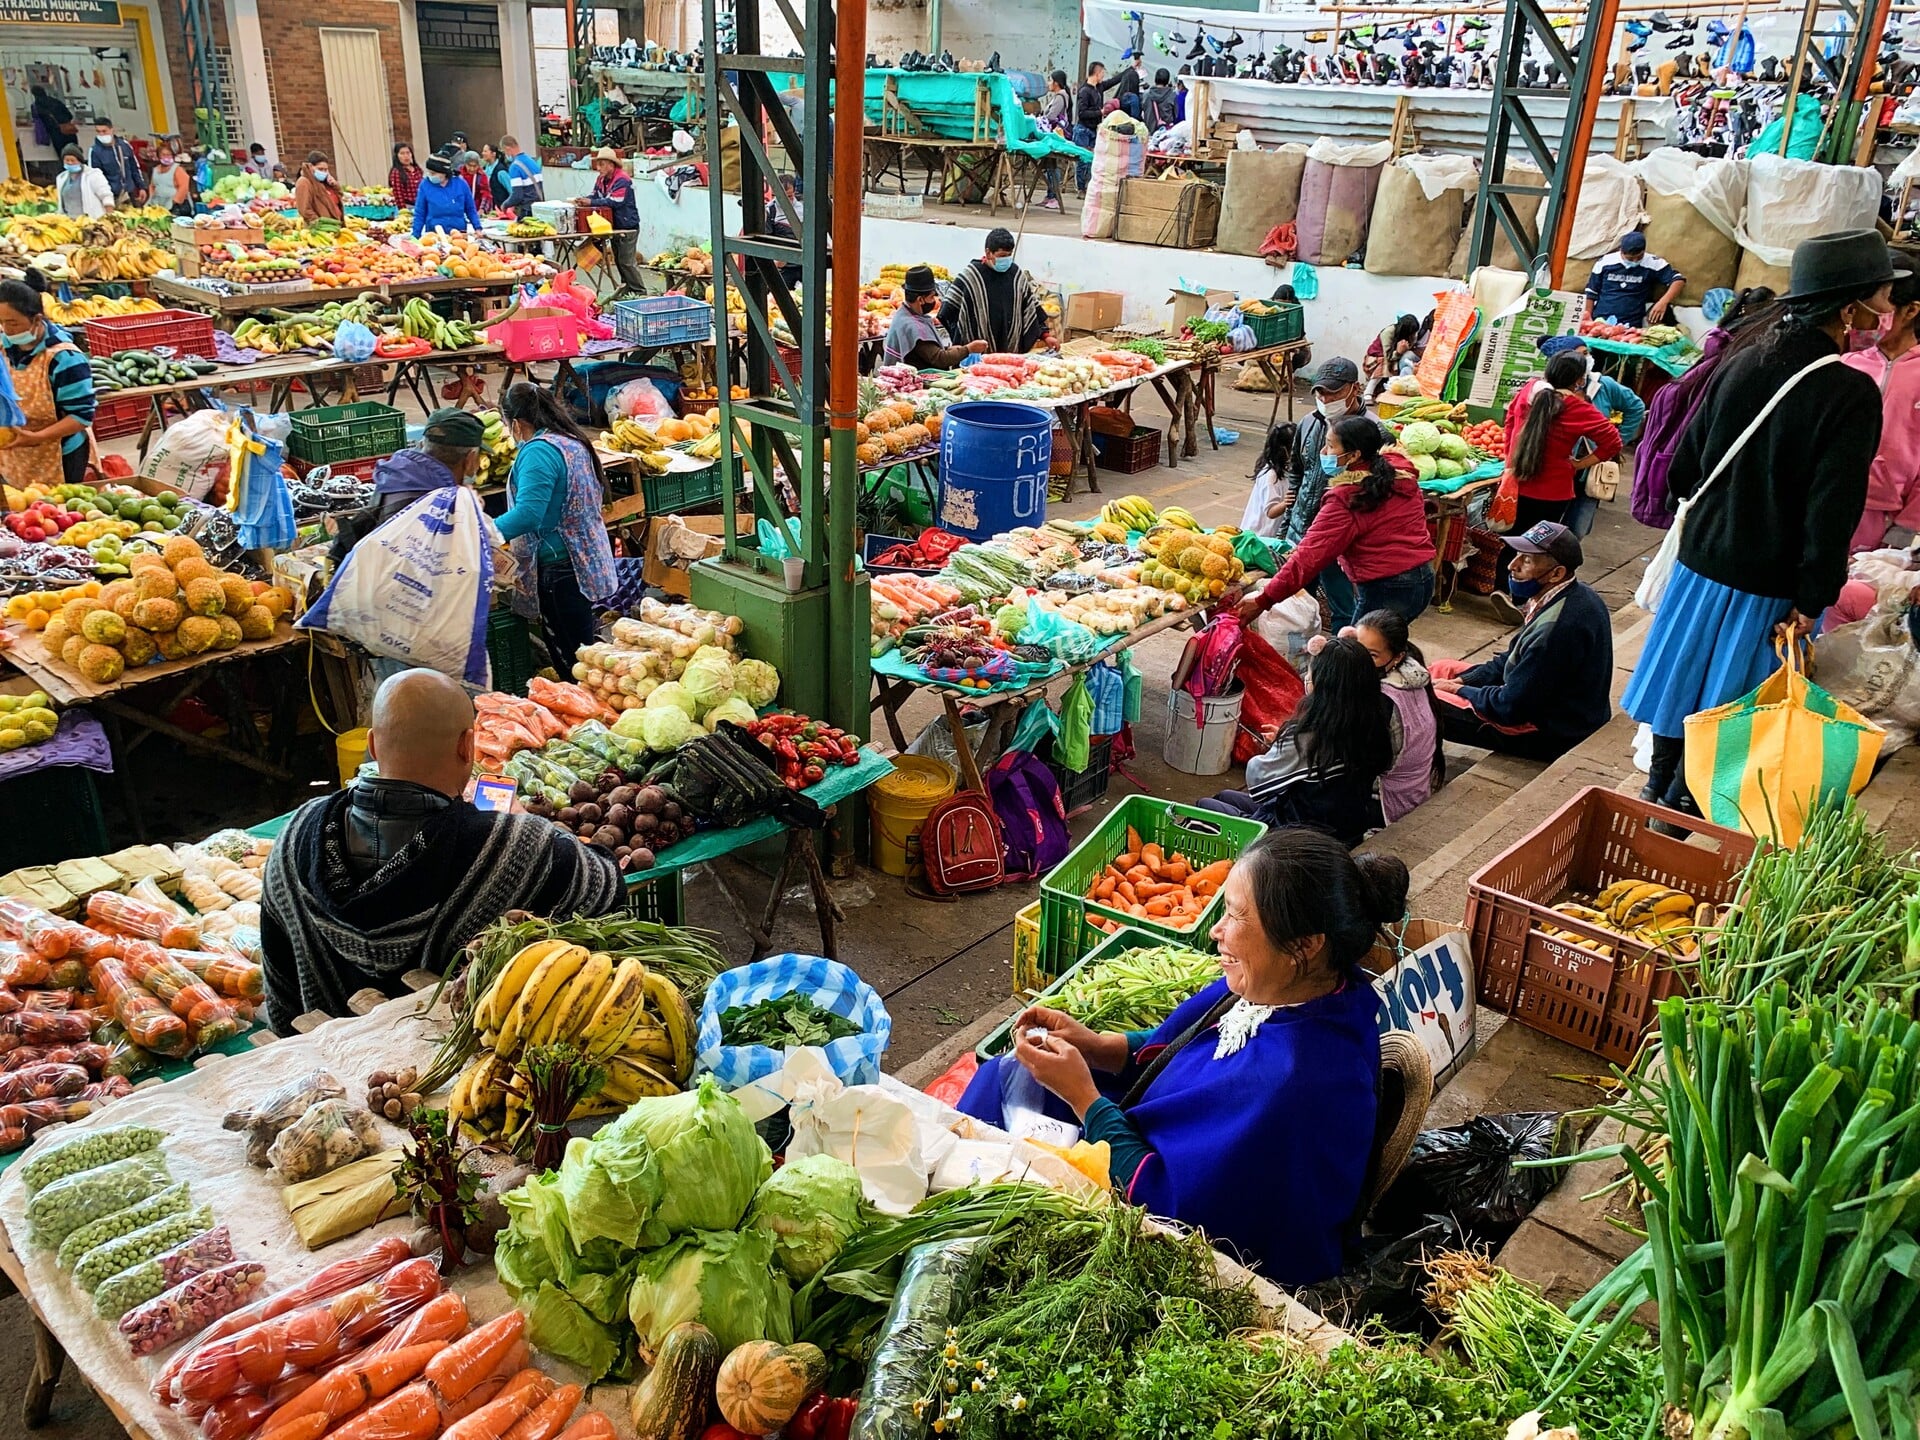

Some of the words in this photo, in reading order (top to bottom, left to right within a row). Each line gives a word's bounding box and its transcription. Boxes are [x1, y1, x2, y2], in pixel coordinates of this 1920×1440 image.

[49, 0, 103, 12] MUNICIPAL
[1482, 331, 1498, 375] NUTRIMON
[1542, 940, 1568, 956] TOBY
[1568, 950, 1595, 967] FRUT
